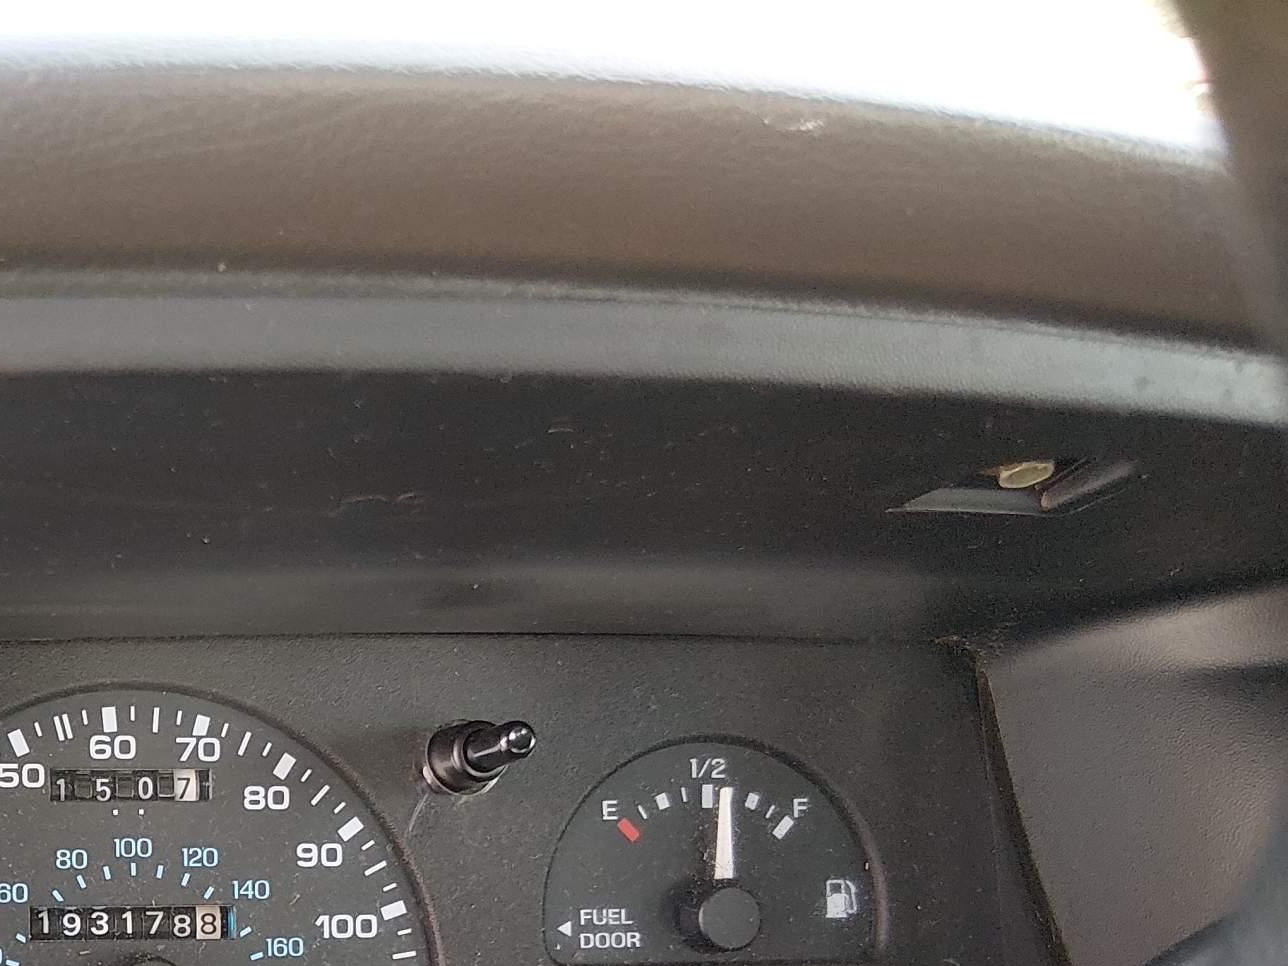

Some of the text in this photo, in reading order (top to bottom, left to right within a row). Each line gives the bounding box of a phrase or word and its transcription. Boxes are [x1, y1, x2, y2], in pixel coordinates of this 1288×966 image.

[89, 734, 136, 760] 60
[175, 737, 221, 762] 70
[689, 758, 726, 779] 1/2
[243, 785, 290, 810] 80
[602, 800, 618, 820] E
[793, 798, 808, 818] F
[113, 838, 153, 858] 100
[181, 847, 219, 867] 120
[296, 842, 343, 868] 90
[55, 849, 88, 869] 80
[232, 879, 270, 900] 140
[37, 910, 217, 938] 1931788
[315, 914, 378, 939] 100
[579, 909, 633, 925] FUEL
[266, 937, 304, 957] 160
[579, 932, 640, 949] DOOR
